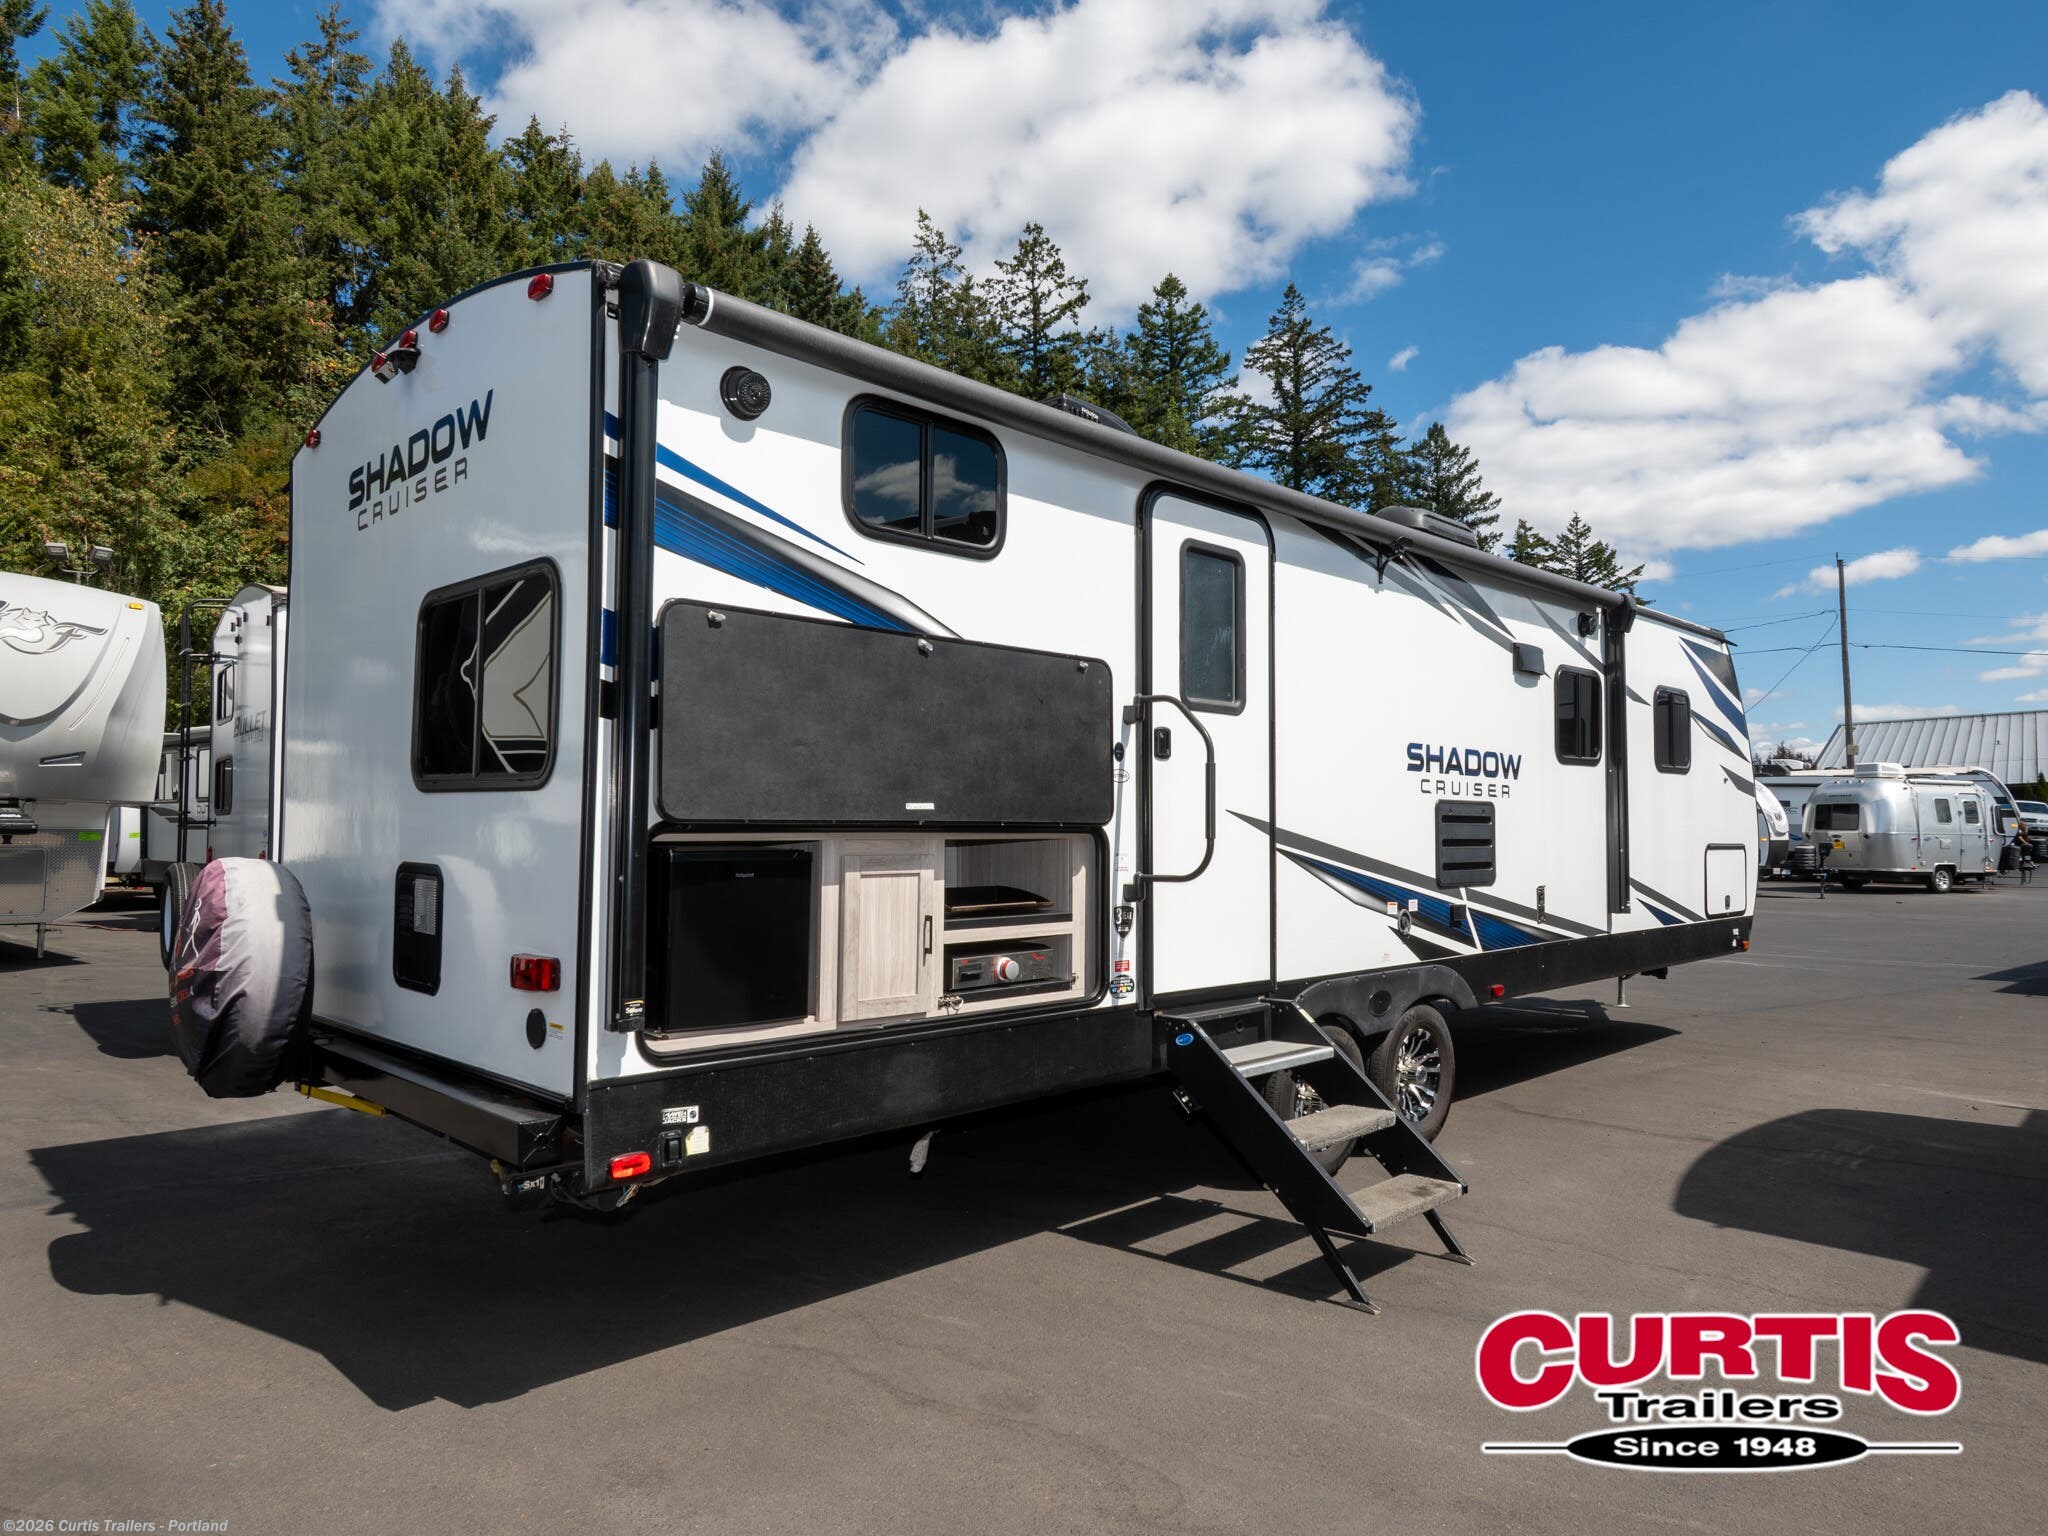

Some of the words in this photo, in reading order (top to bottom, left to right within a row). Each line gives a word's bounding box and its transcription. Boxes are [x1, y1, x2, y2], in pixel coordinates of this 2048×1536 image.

[348, 388, 493, 512] SHADOW
[357, 457, 468, 531] CRUISER
[233, 710, 266, 738] BULLET
[1406, 742, 1522, 780] SHADOW
[1420, 778, 1511, 798] CRUISER
